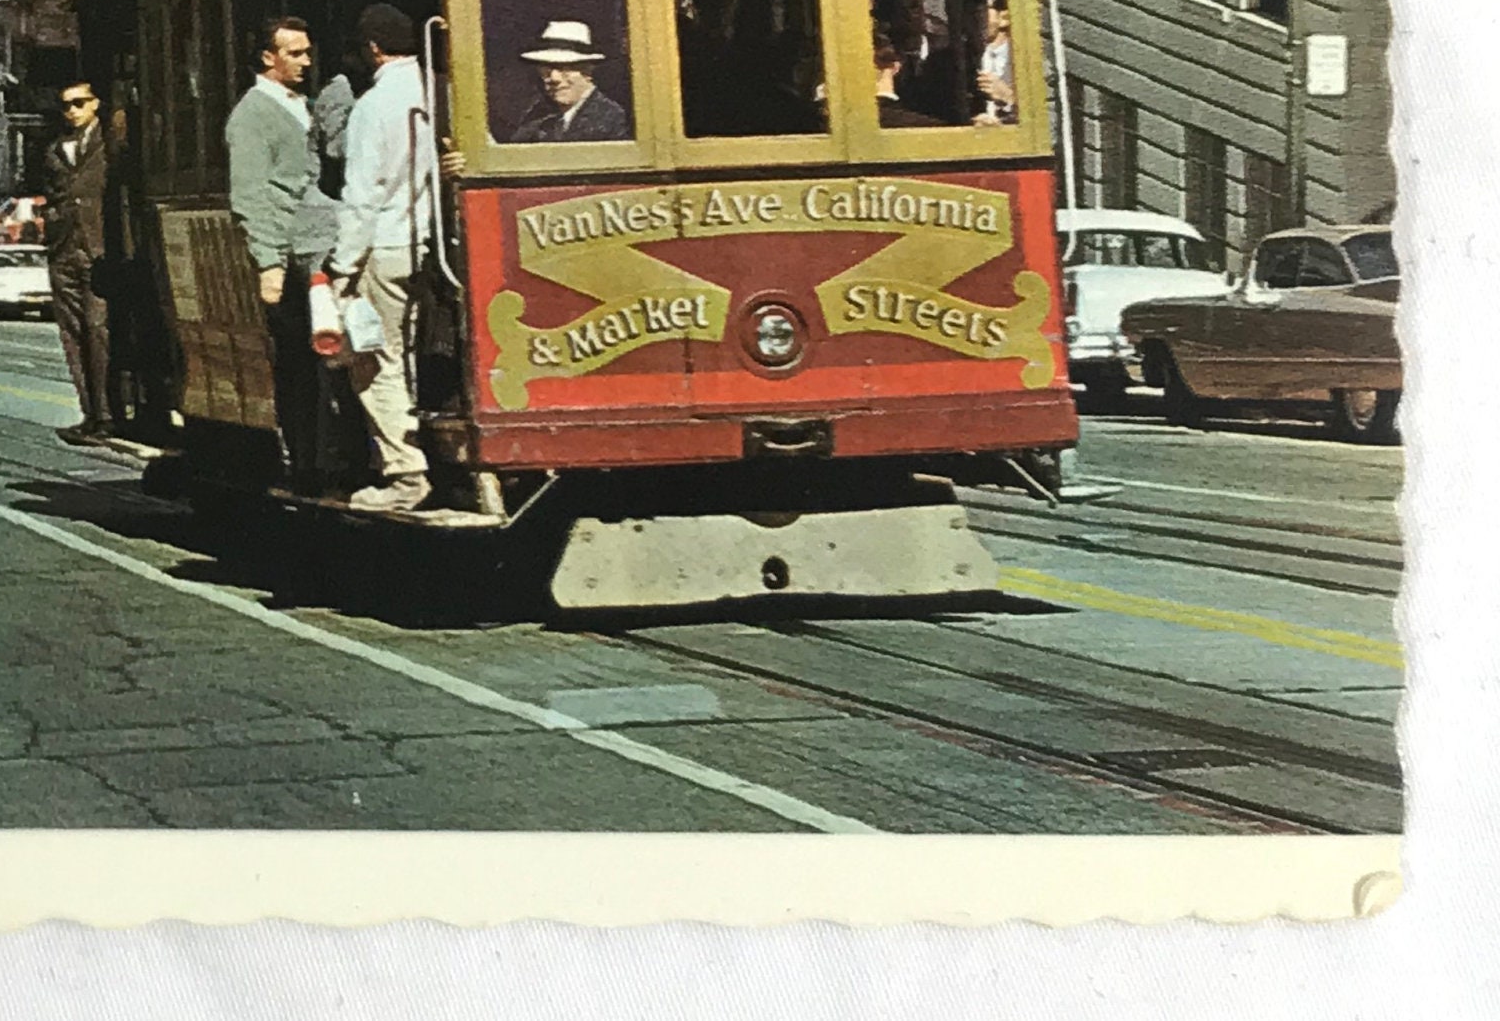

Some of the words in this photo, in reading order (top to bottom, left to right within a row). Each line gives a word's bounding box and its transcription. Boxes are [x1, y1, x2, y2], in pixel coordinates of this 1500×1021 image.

[523, 210, 597, 250] Van
[594, 197, 694, 236] Ness
[803, 183, 999, 233] California
[528, 334, 563, 366] &
[566, 293, 710, 361] Market
[843, 284, 1009, 348] Streets
